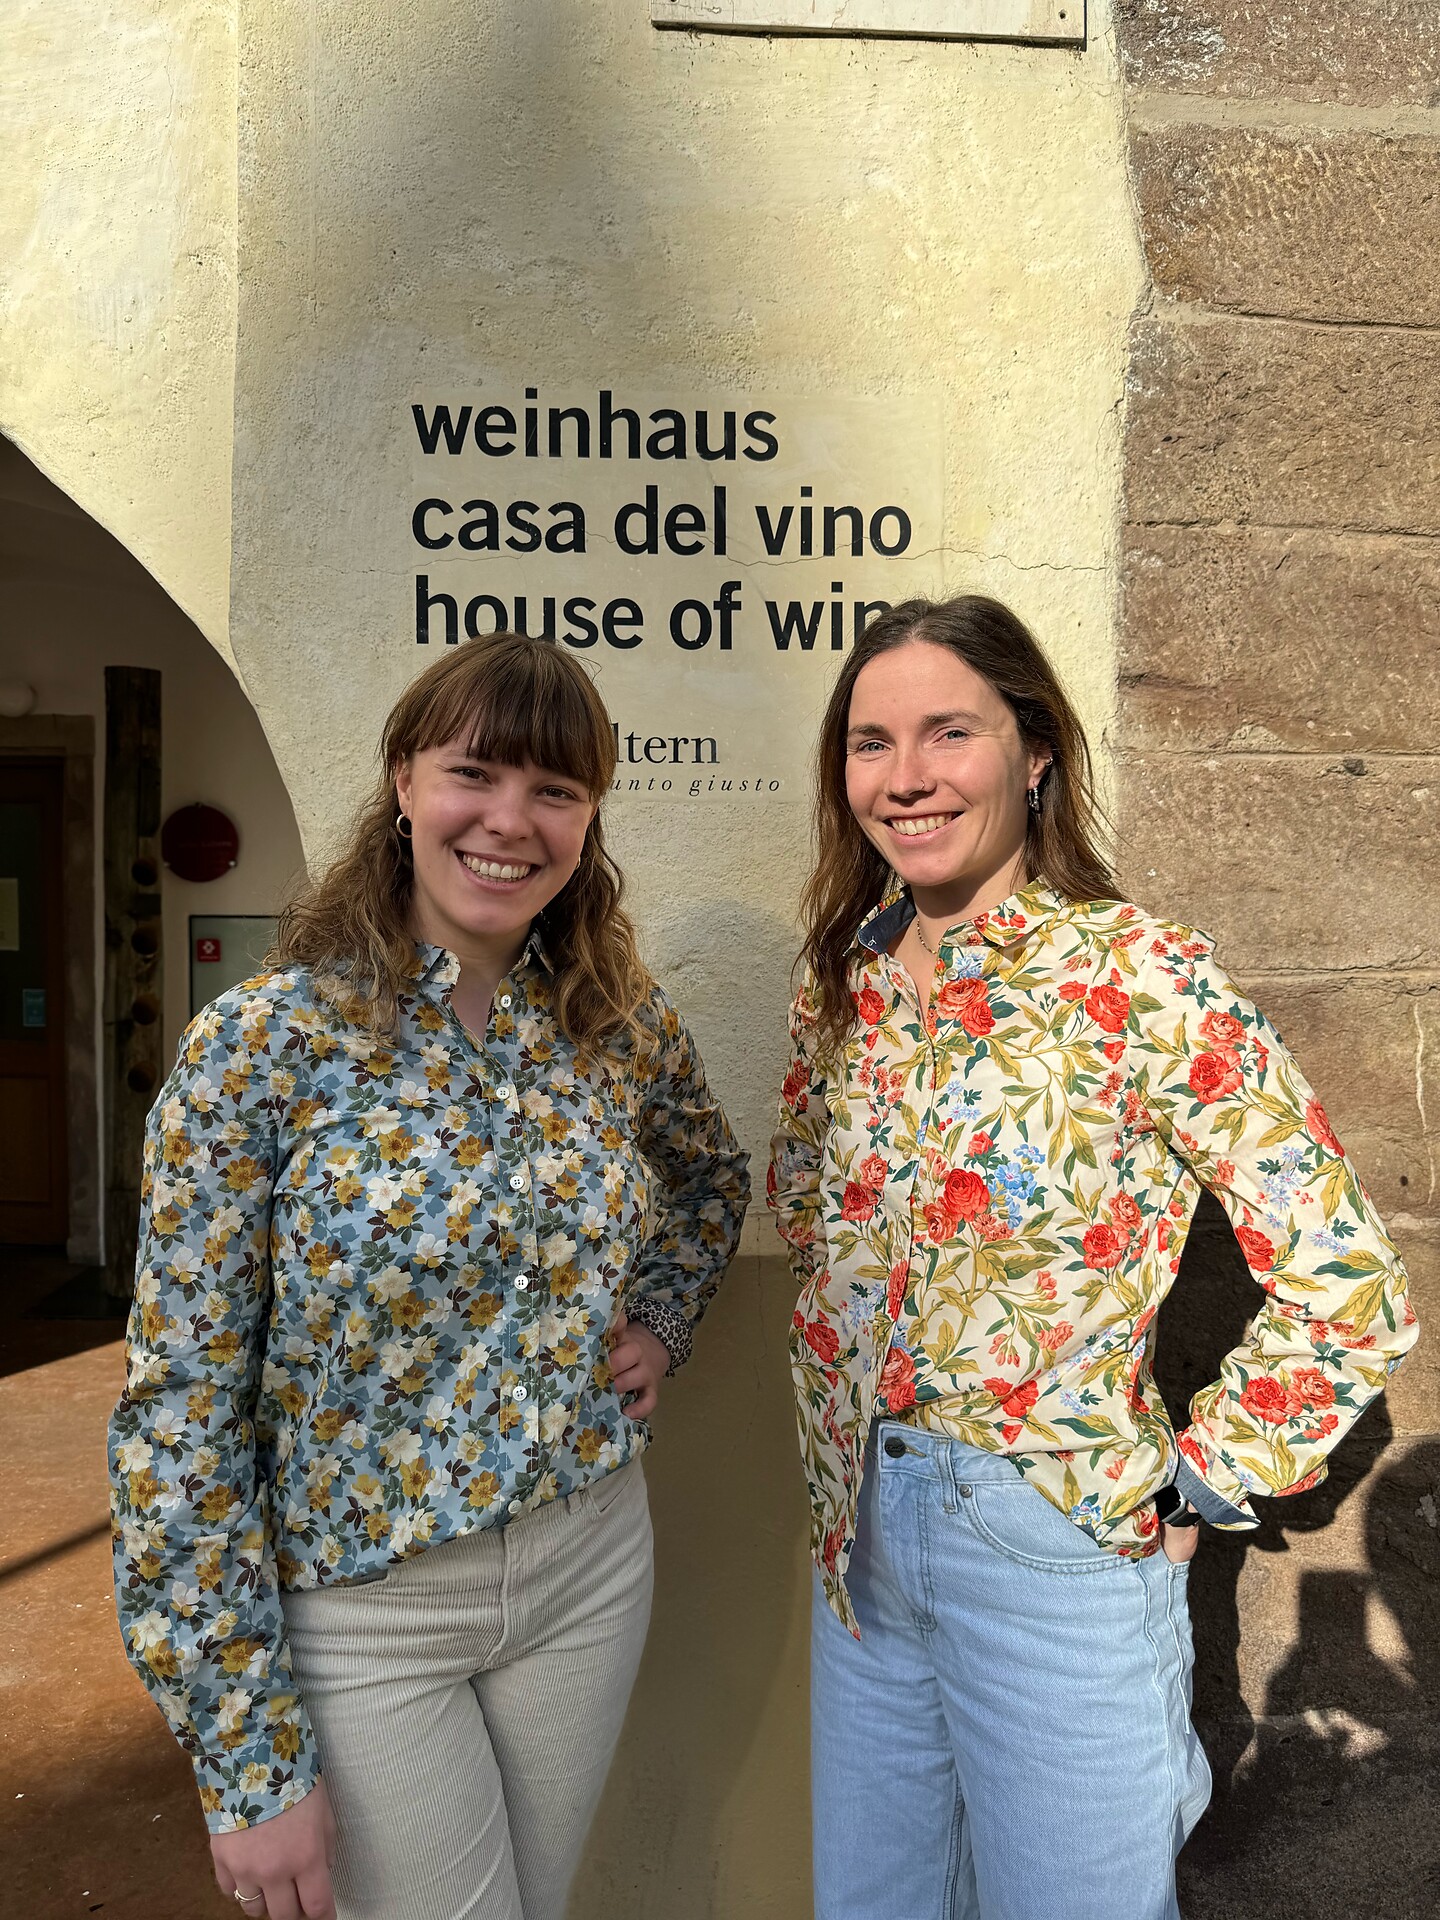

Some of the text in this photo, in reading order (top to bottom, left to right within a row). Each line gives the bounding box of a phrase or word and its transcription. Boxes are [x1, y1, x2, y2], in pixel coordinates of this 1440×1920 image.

[411, 387, 779, 461] weinhaus
[411, 484, 912, 557] casa del vino
[415, 574, 644, 649] house
[669, 580, 742, 650] of
[688, 774, 780, 797] giusto
